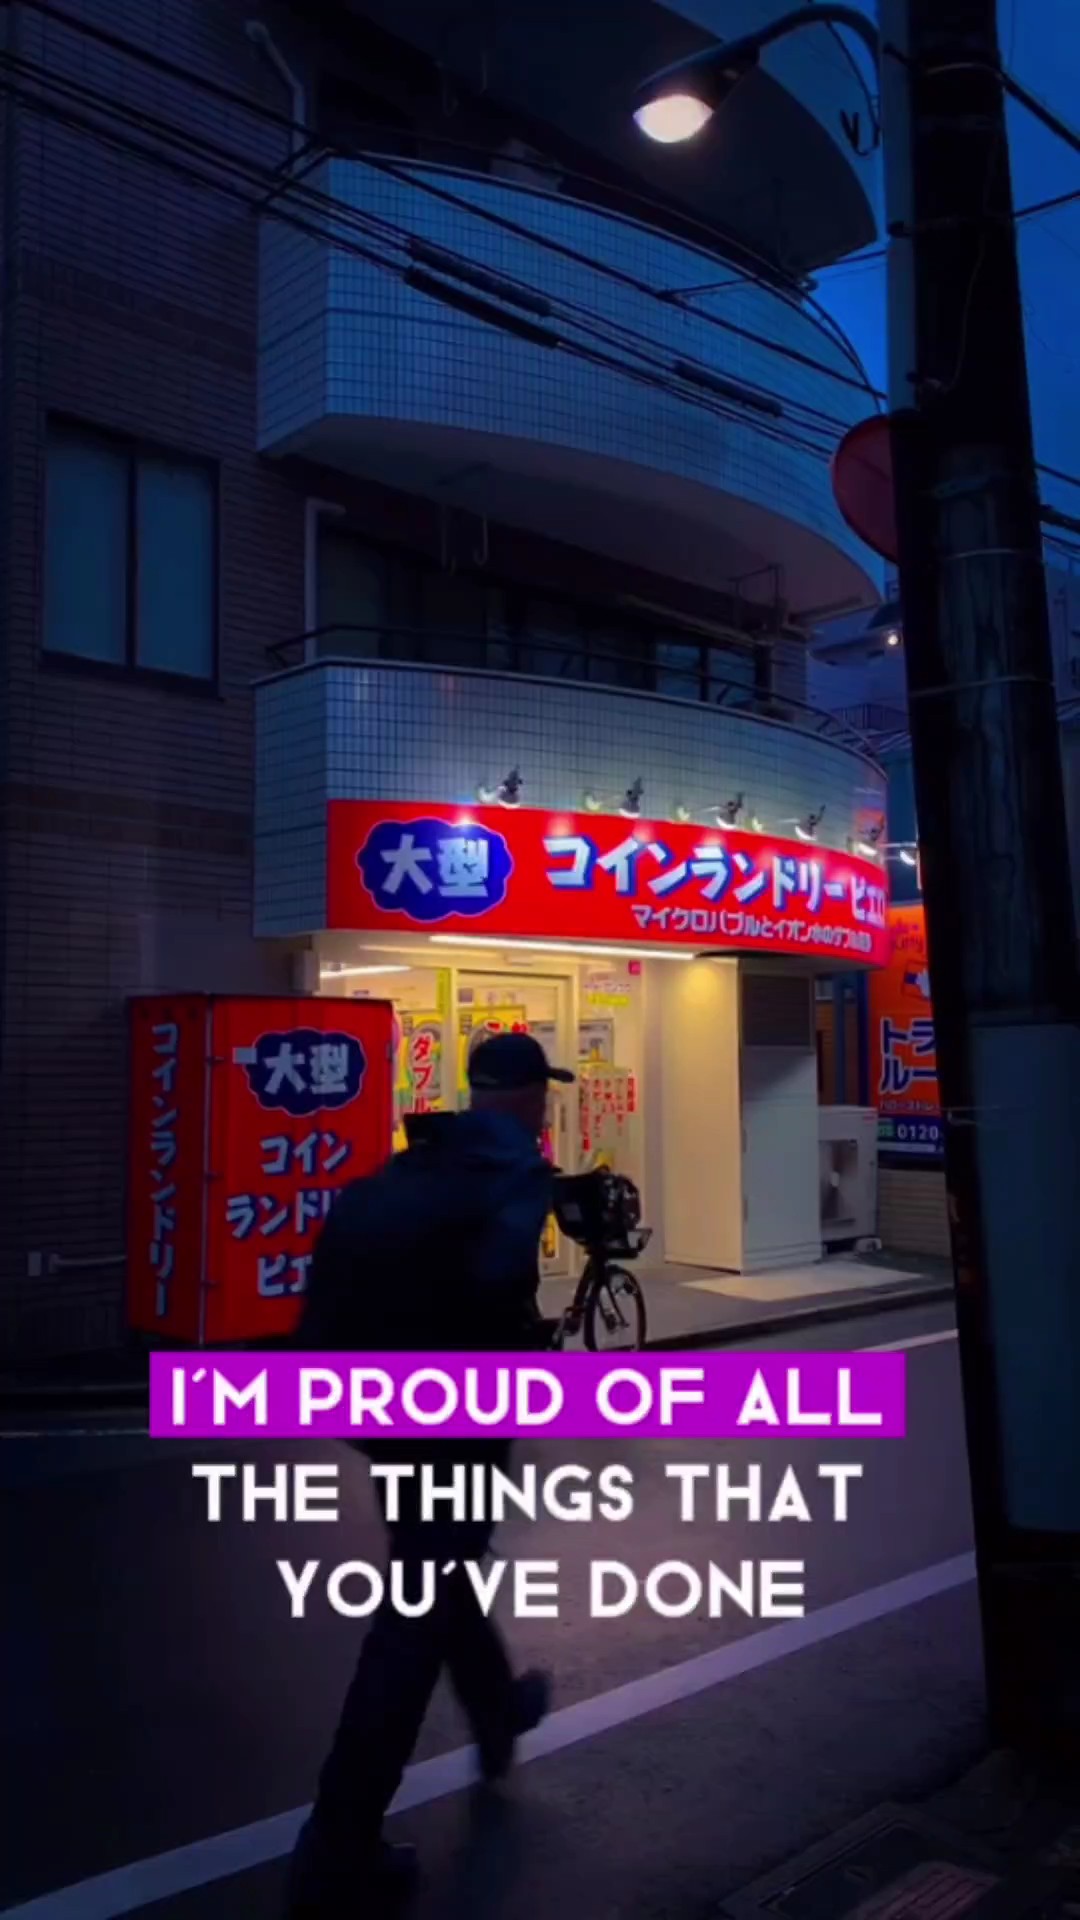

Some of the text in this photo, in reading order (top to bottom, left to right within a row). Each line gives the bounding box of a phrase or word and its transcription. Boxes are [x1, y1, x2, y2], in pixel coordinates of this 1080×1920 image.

[379, 833, 491, 899] 大型
[263, 1041, 350, 1096] 大型
[148, 1022, 179, 1318] コインランドリー
[259, 1132, 350, 1176] コイン
